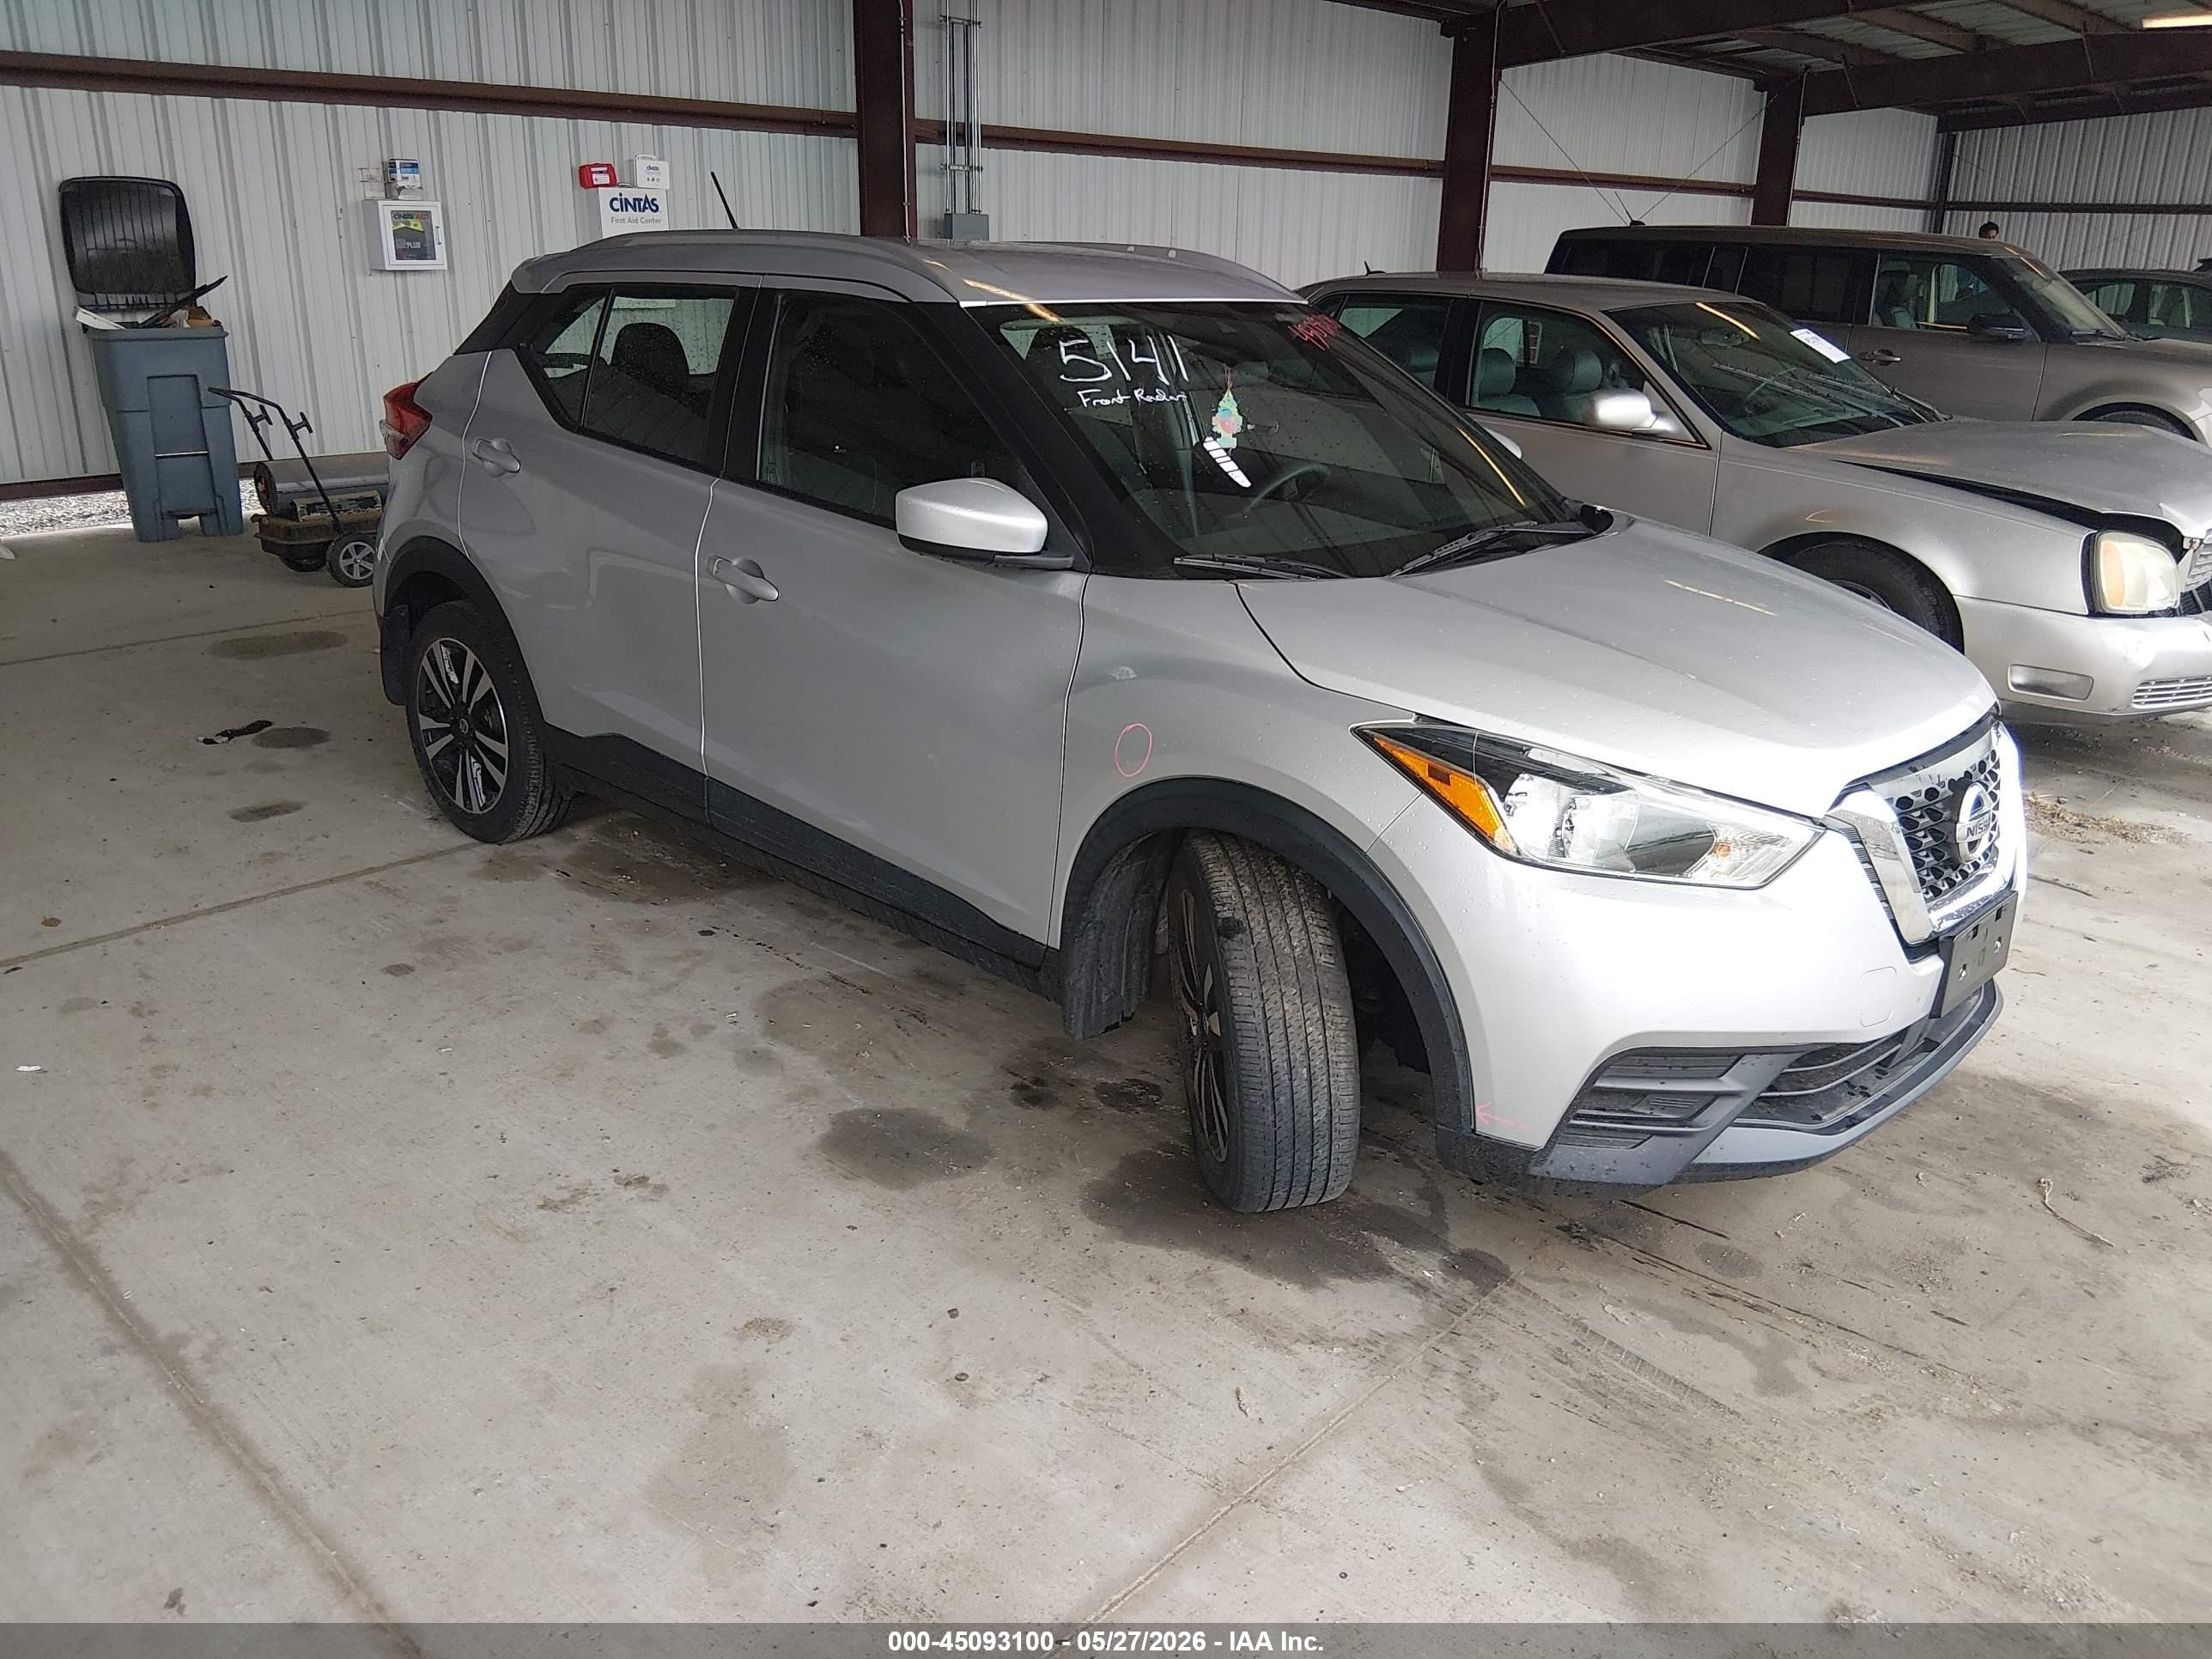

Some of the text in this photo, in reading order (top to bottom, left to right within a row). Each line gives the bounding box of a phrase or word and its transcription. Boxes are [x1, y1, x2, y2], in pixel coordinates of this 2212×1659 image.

[611, 216, 662, 225] First Aid Center
[1058, 335, 1190, 386] 5141
[1077, 388, 1132, 408] Front
